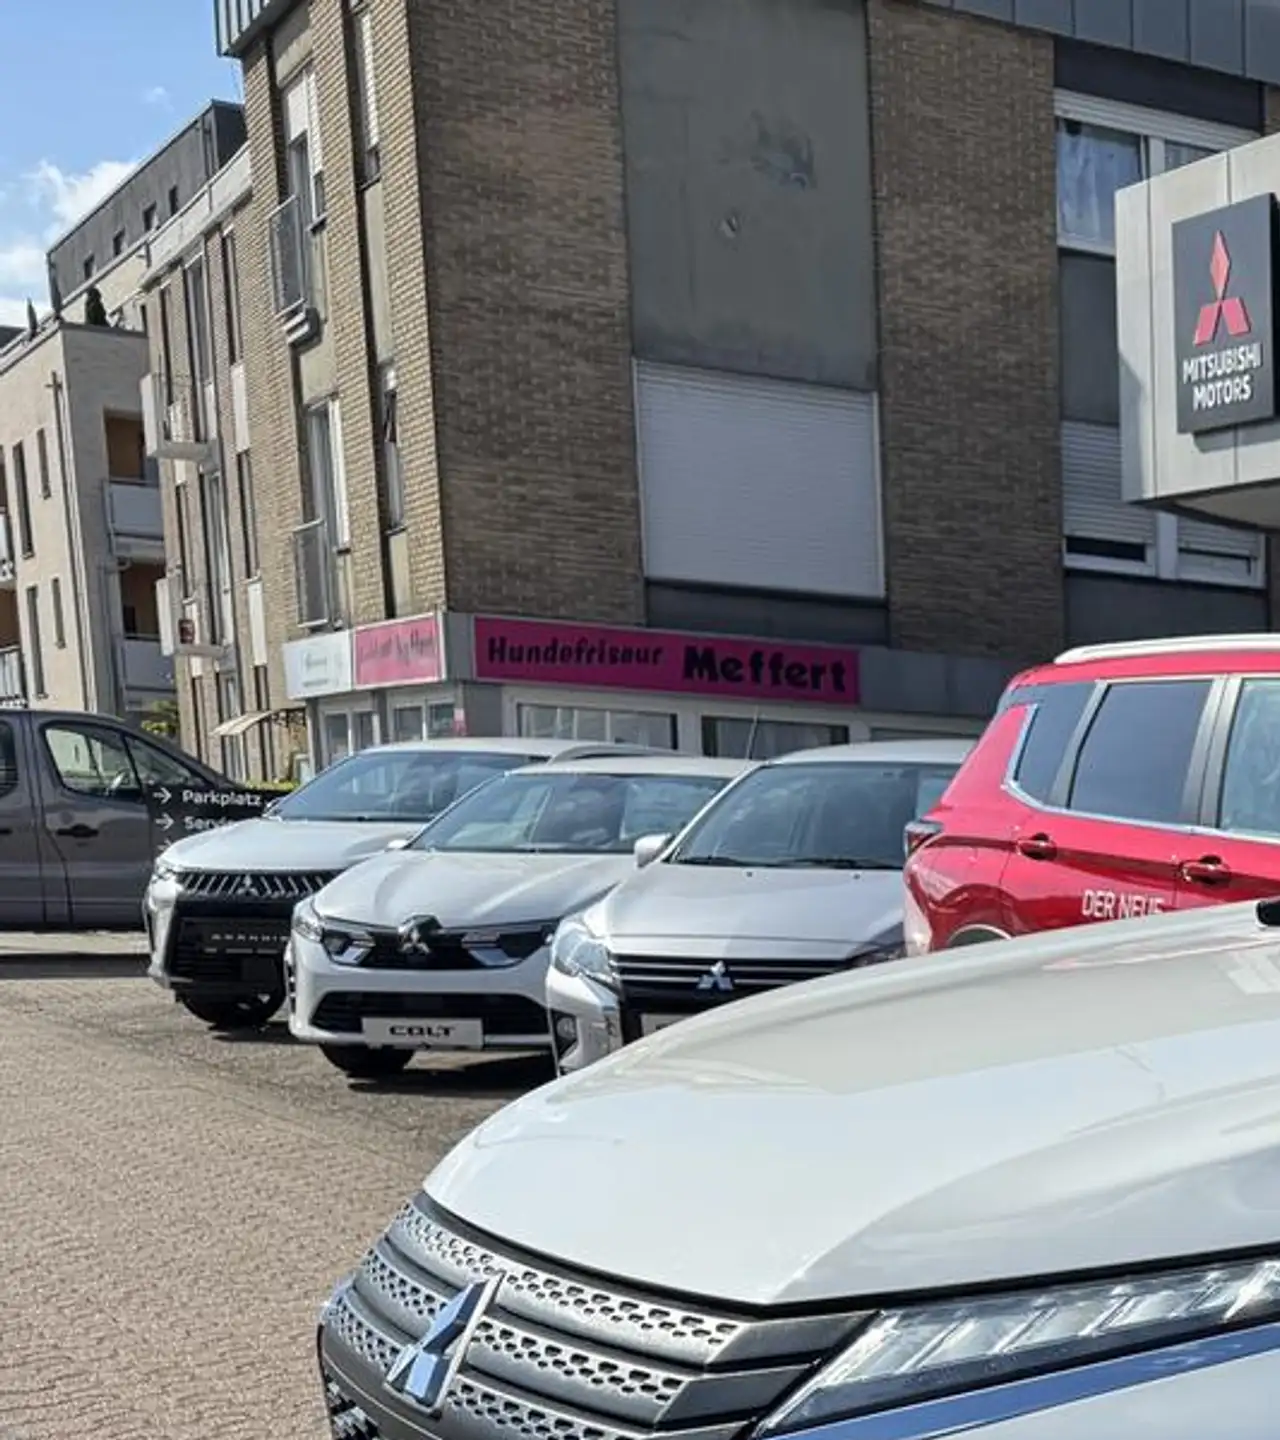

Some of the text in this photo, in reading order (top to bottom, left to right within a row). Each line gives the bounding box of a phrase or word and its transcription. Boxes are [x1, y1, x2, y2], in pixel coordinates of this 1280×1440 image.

[1183, 341, 1262, 385] MITSUBISHI
[1192, 373, 1252, 411] MOTORS
[488, 637, 846, 693] Hundefriseur Meffert
[182, 789, 261, 807] Parkplatz
[1082, 889, 1166, 919] DER NEUE
[389, 1023, 455, 1038] COLT
